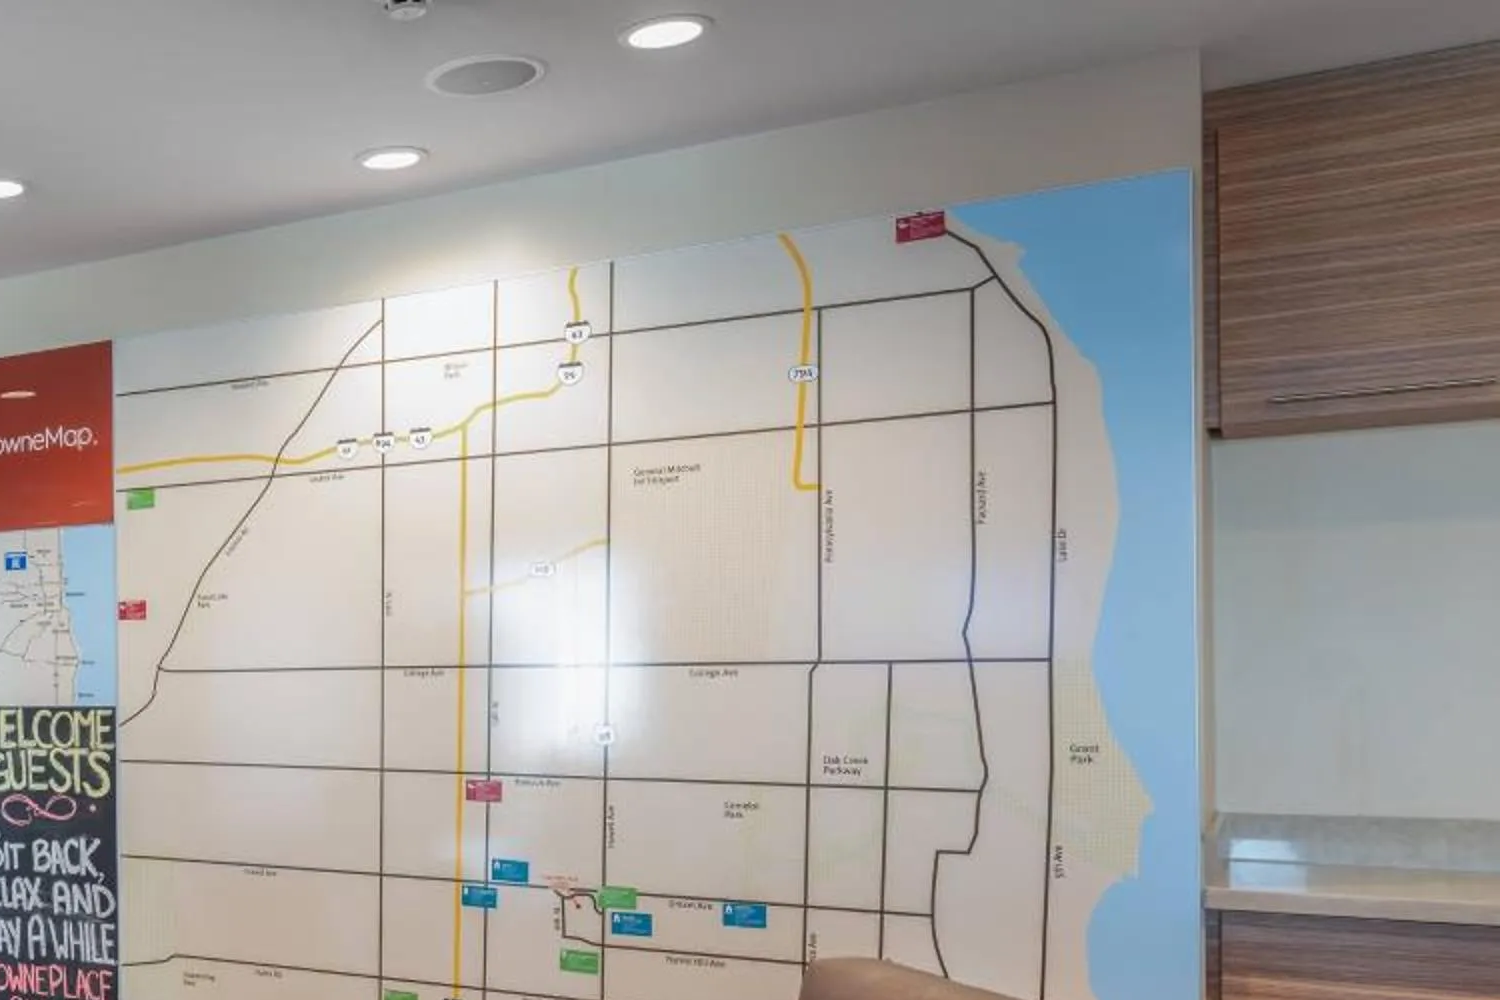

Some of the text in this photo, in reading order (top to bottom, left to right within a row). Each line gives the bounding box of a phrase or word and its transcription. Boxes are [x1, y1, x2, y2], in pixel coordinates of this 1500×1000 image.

[31, 837, 105, 886] BACK,
[51, 879, 116, 919] AND
[28, 917, 49, 958] A
[48, 918, 116, 965] WHILE
